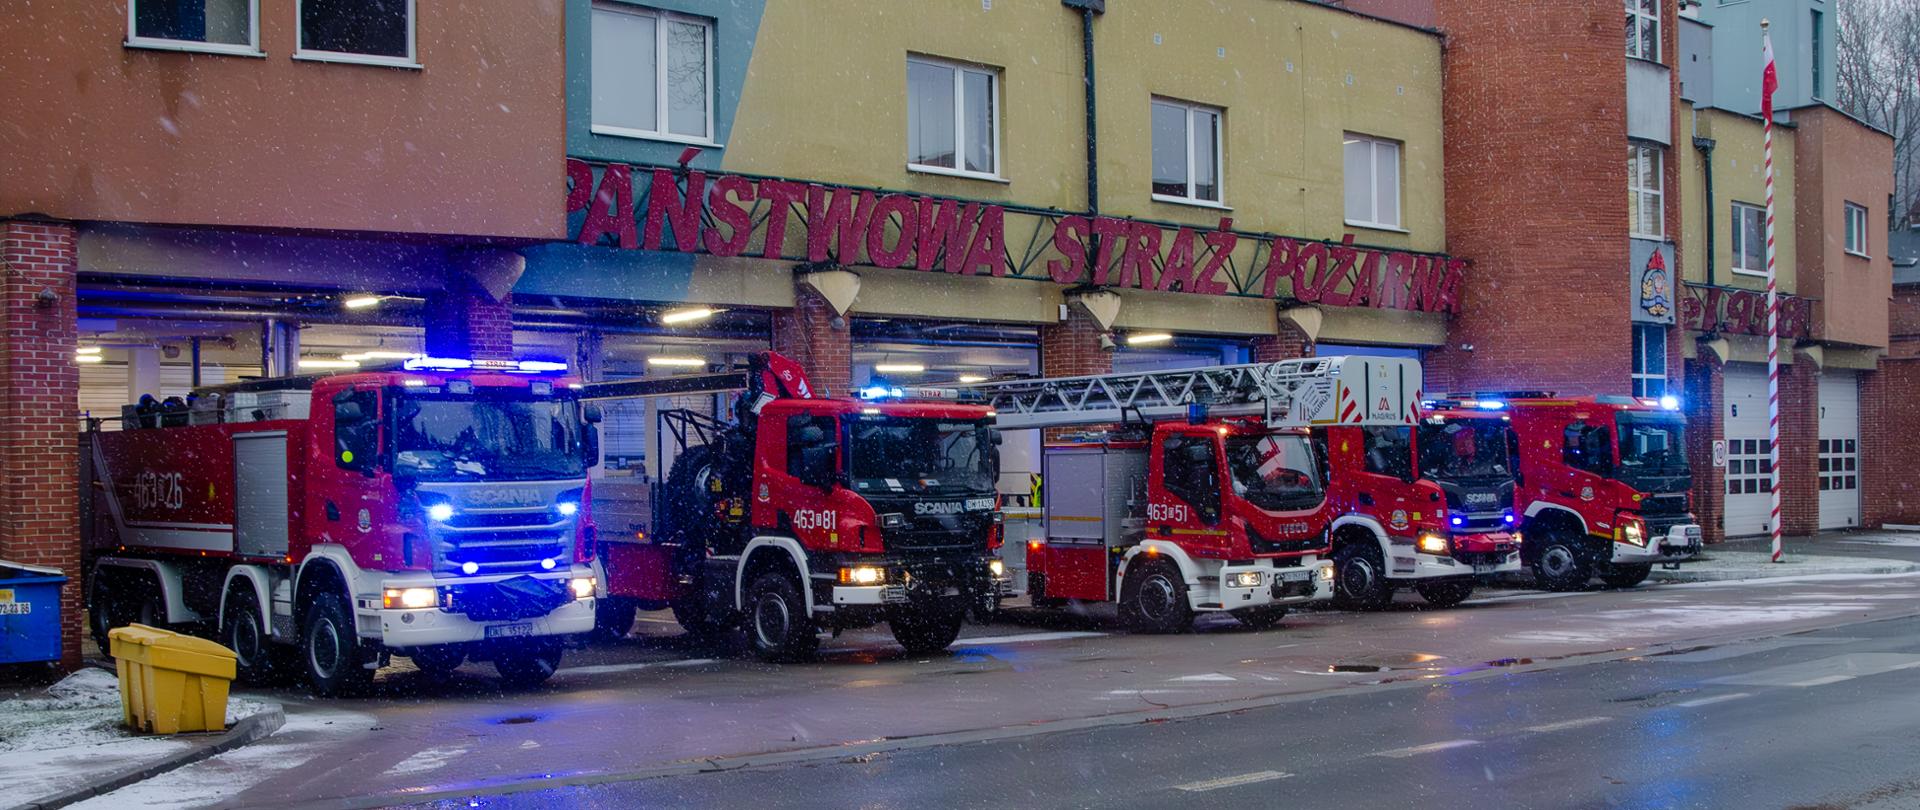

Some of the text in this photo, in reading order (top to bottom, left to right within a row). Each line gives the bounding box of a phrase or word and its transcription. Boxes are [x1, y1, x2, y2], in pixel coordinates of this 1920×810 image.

[1047, 215, 1238, 295] STRAŻ
[1263, 233, 1467, 314] POŻARNA
[1731, 404, 1738, 418] 6
[1821, 406, 1826, 419] 7
[470, 487, 544, 505] SCANIA
[1465, 493, 1497, 505] SCANIA
[914, 501, 964, 515] SCANIA
[1279, 521, 1309, 534] IVECO
